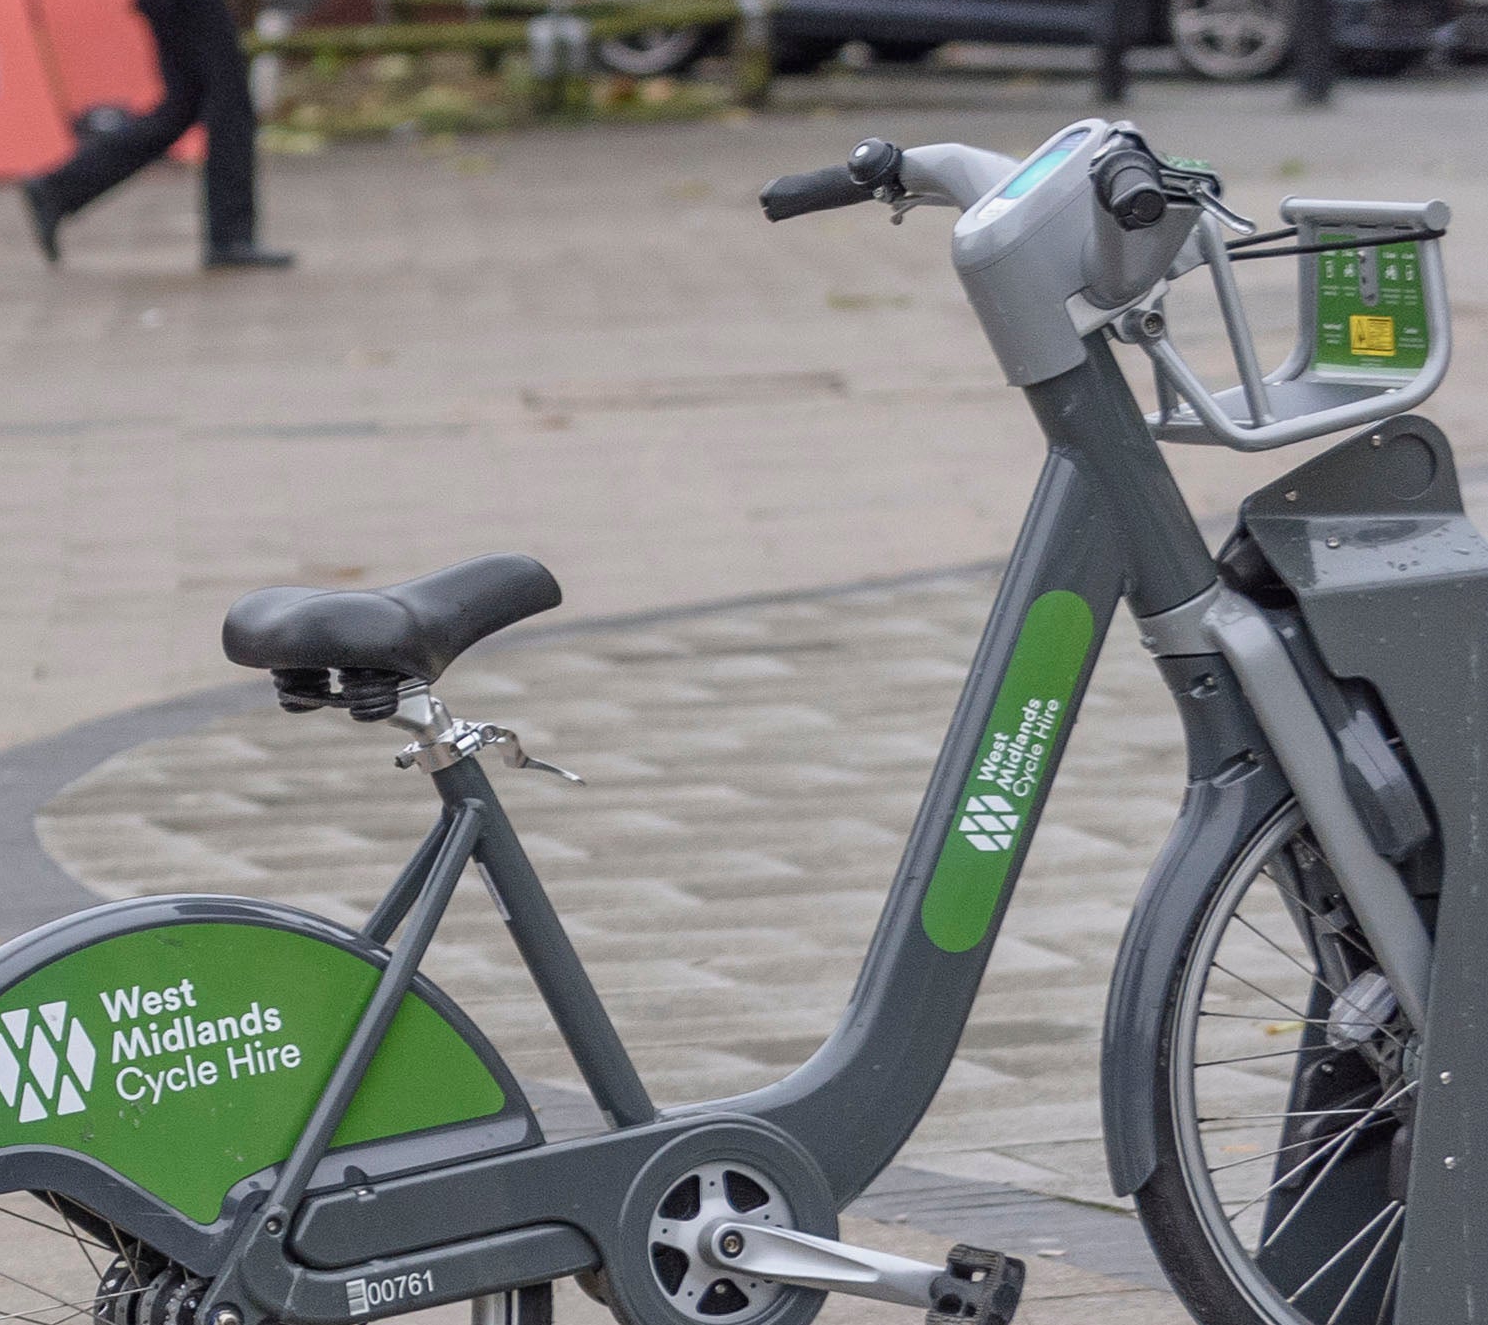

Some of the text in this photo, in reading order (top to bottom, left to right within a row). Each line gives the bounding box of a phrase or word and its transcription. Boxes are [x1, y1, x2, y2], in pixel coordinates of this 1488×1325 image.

[977, 732, 1010, 782] West
[996, 698, 1042, 792] Midlands
[1012, 699, 1060, 797] Cycle Hire
[99, 978, 197, 1023] West
[111, 1002, 283, 1064] Midlands
[116, 1040, 302, 1105] Cycle Hire
[367, 1269, 434, 1305] 00761
